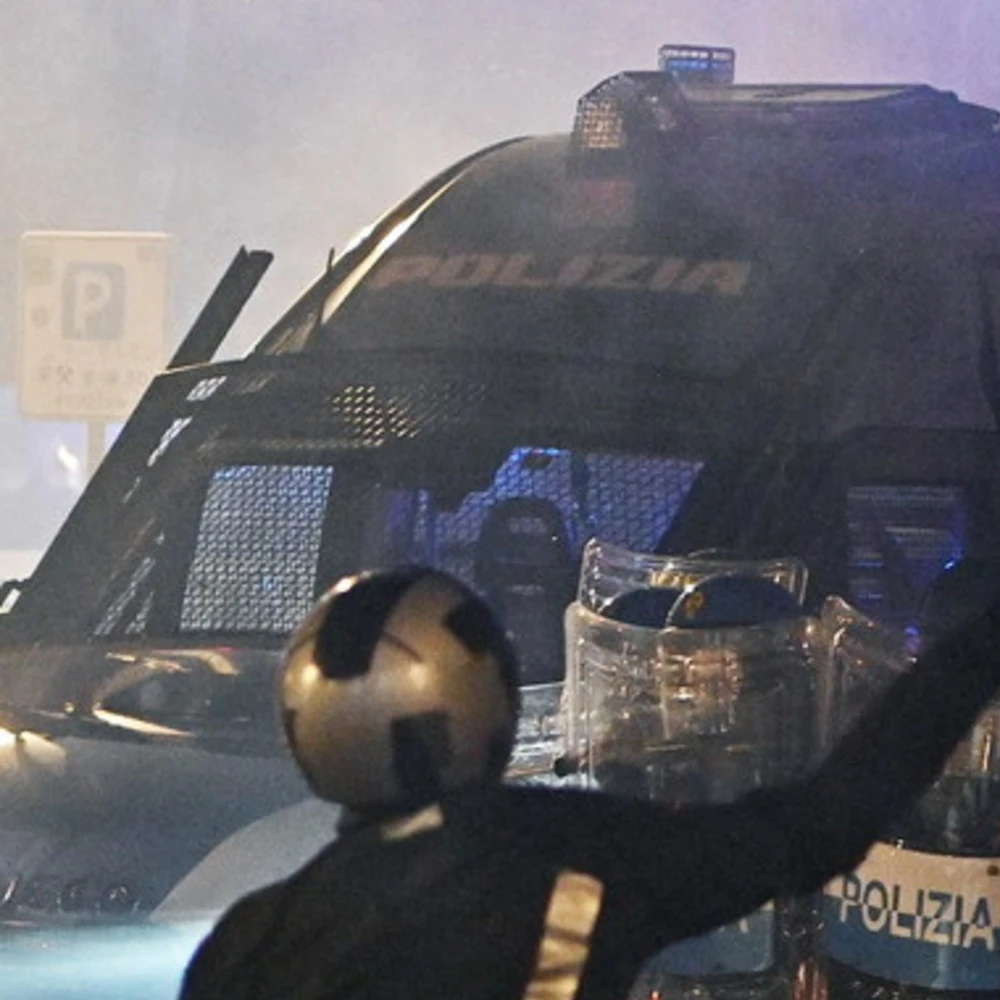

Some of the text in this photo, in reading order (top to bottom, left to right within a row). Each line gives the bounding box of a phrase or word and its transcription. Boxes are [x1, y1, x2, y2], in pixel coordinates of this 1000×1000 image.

[74, 269, 114, 338] P
[369, 252, 751, 296] POLIZIA
[840, 874, 995, 951] POLIZIA
